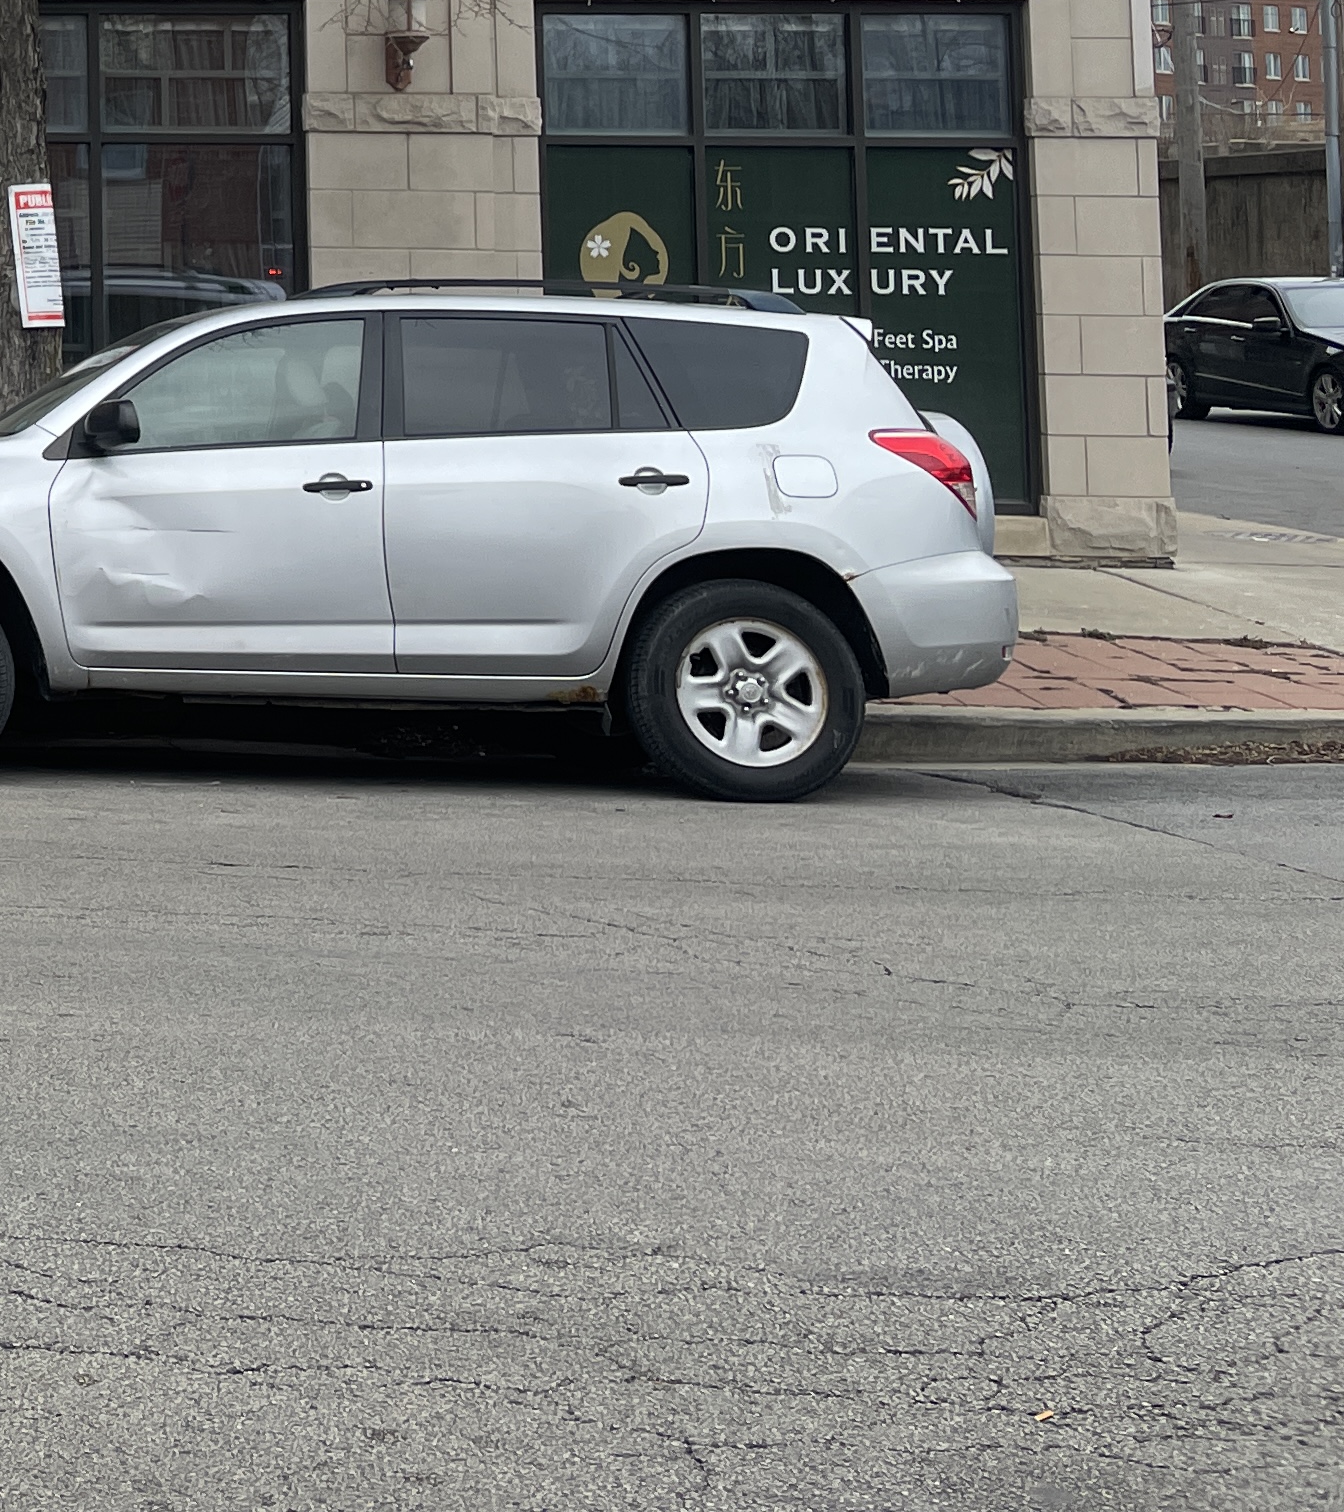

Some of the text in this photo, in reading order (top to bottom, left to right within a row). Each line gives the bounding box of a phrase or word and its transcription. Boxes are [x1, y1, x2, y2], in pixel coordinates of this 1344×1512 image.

[769, 226, 1009, 255] ORIENTAL
[771, 268, 954, 296] LUXURY
[873, 328, 957, 353] Feet Spa
